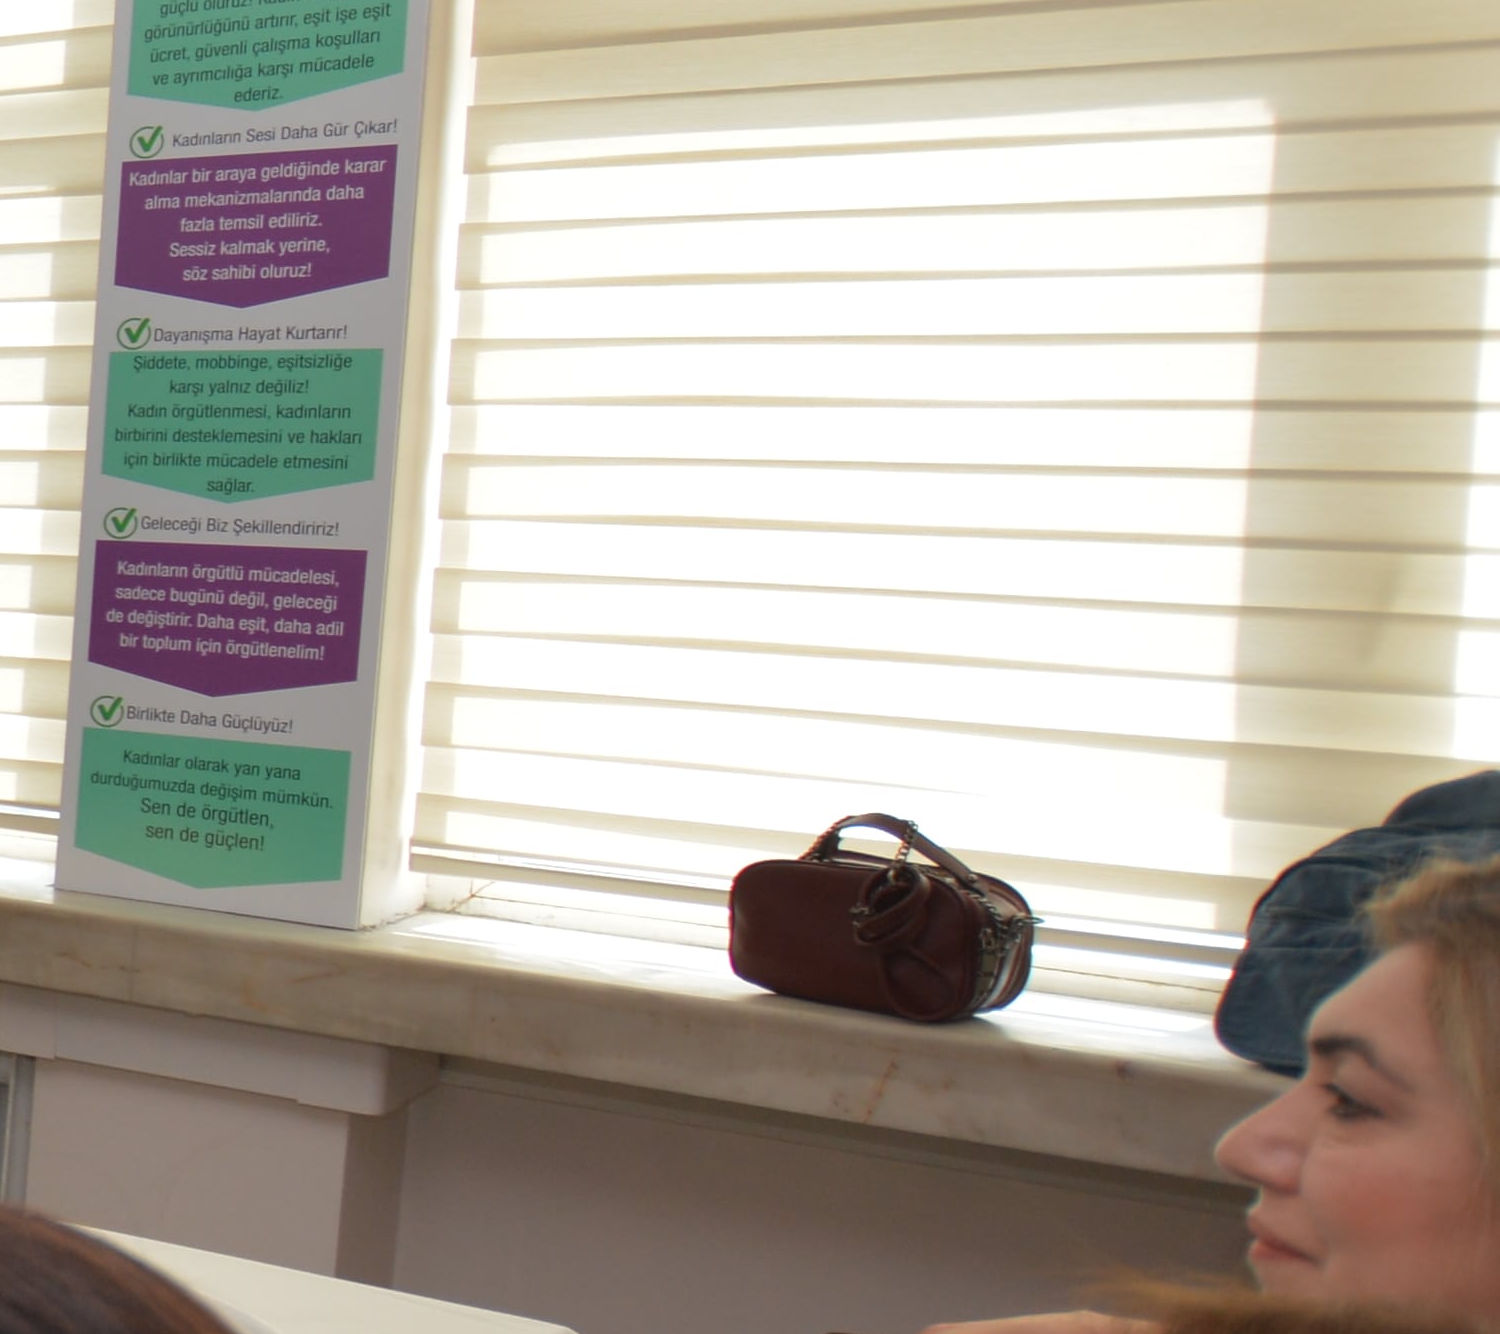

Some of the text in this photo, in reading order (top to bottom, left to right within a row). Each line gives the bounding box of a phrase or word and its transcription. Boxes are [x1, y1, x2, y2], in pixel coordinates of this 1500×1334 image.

[254, 14, 297, 29] artırır,
[303, 8, 330, 27] eşit
[335, 6, 357, 24] işe
[362, 2, 390, 21] eşit
[150, 29, 380, 63] ücret, güvenli çalışma koşulları
[152, 53, 374, 86] ve ayrımcılığa karşı mücadele
[233, 85, 282, 102] ederiz.
[172, 118, 397, 147] Kadınların Sesi Daha Gür Çıkar!
[129, 158, 387, 186] Kadınlar bir araya geldiğinde karar
[144, 194, 179, 209] alma
[325, 184, 364, 200] daha
[180, 211, 322, 232] fazla temsil ediliriz.
[169, 237, 329, 257] Sessiz kalmak yerine,
[182, 262, 311, 281] söz sahibi oluruz!
[153, 324, 347, 344] Dayanışma Hayat Kurtarır!
[133, 353, 352, 372] Şiddete, mobbinge, eşitsizliğe
[169, 378, 308, 396] karşı yalnız değiliz!
[127, 404, 167, 418] Kadın
[276, 404, 351, 419] kadınların
[114, 427, 167, 441] birbirini
[287, 432, 305, 443] ve
[310, 429, 362, 444] hakları
[123, 452, 348, 469] için birlikte mücadele etmesini
[206, 477, 254, 495] sağlar.
[140, 515, 201, 534] Geleceği
[206, 517, 228, 532] Biz
[117, 560, 339, 587] Kadınların örgütlü mücadelesi,
[115, 585, 337, 613] sadece bugünü değil, geleceği
[105, 608, 344, 636] de değiştirir. Daha eşit, daha adil
[119, 632, 139, 647] bir
[142, 634, 191, 652] toplum
[195, 637, 221, 656] için
[126, 705, 292, 734] Birlikte Daha Güçlüyüz!
[123, 749, 300, 780] Kadınlar olarak yan yana
[199, 781, 256, 802] değişim
[262, 789, 332, 808] mümkün.
[140, 797, 273, 828] Sen de örgütlen,
[145, 825, 264, 851] sen de güçlen!
